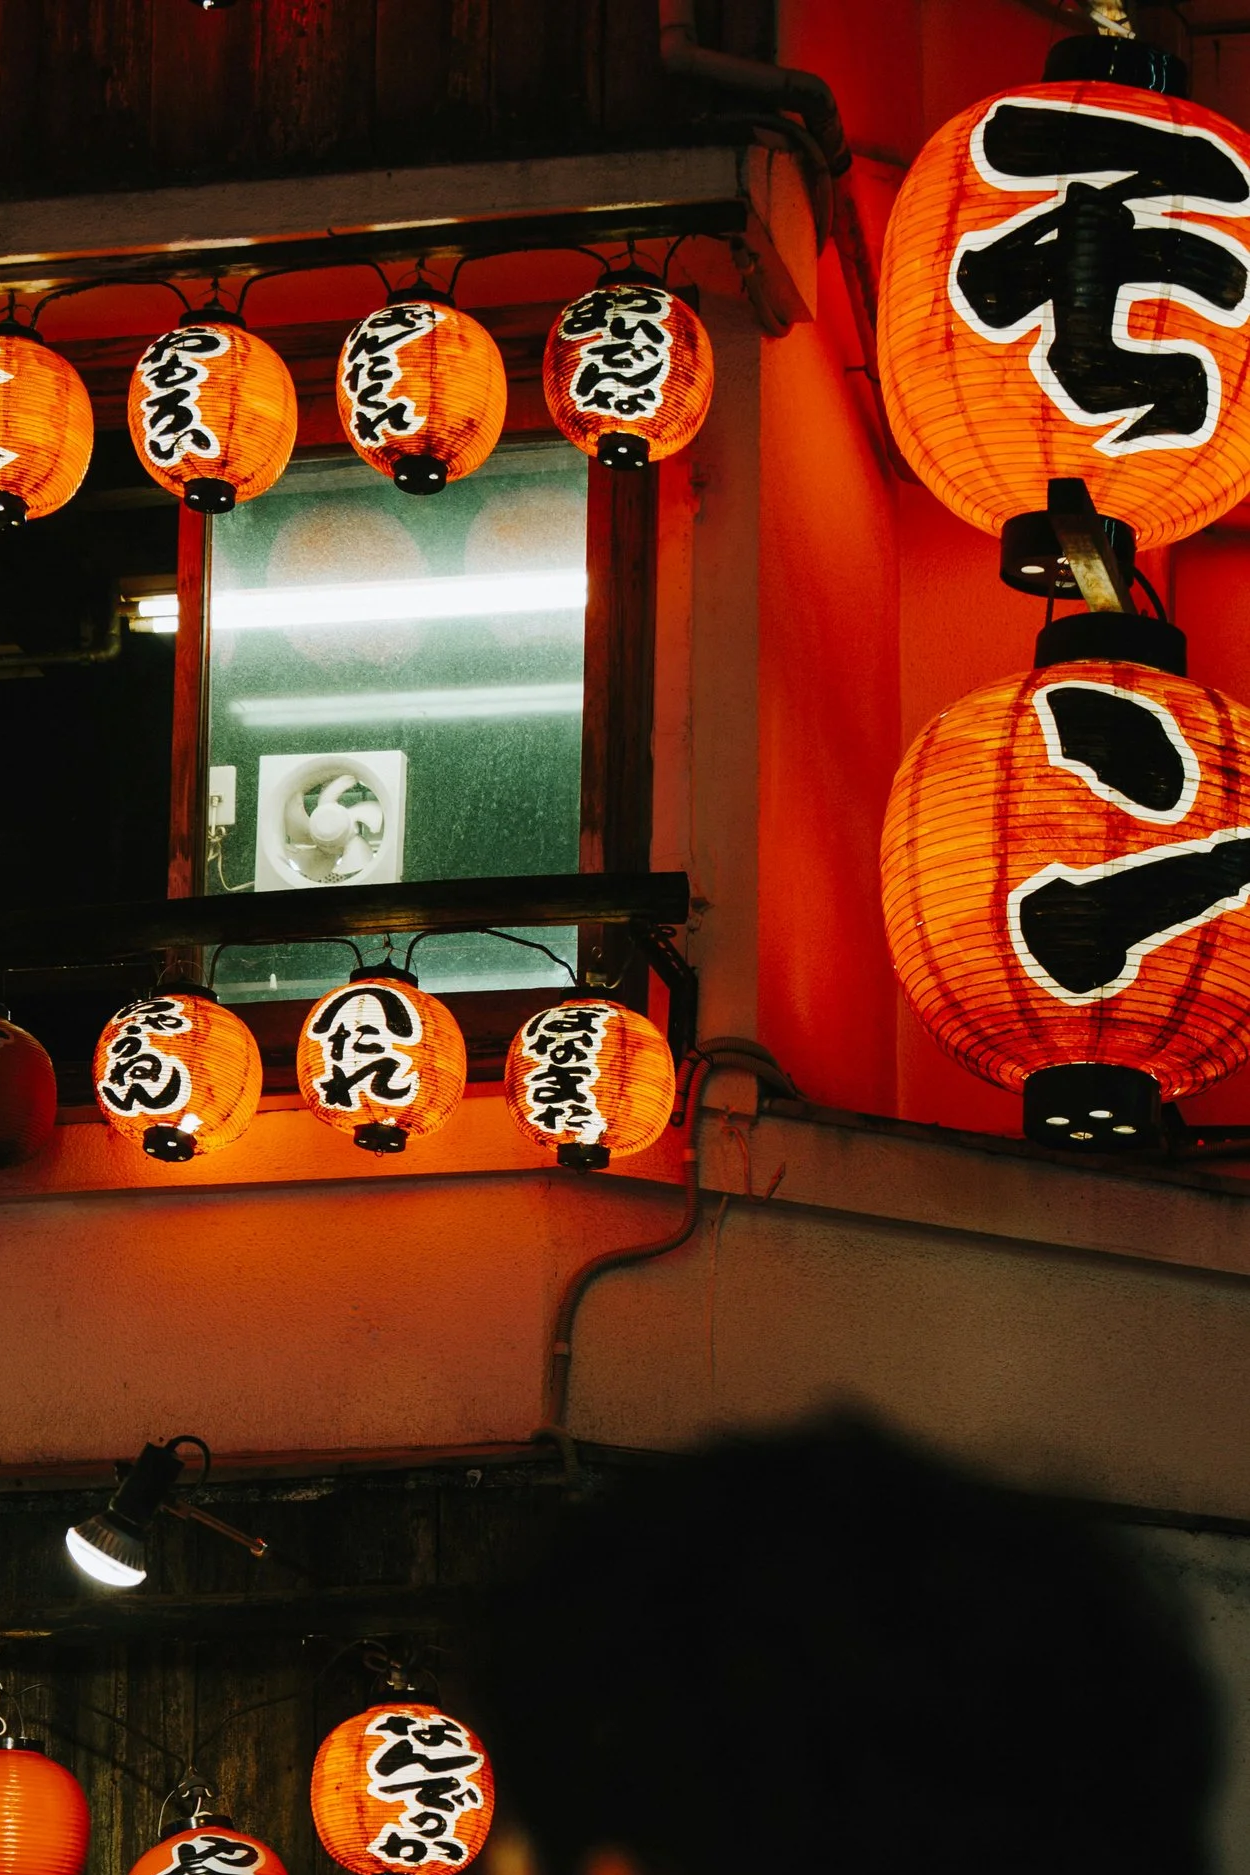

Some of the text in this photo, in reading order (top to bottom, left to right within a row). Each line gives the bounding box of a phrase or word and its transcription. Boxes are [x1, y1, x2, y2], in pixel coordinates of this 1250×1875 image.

[312, 987, 414, 1108] へたれ
[526, 1007, 609, 1129] ほなまた
